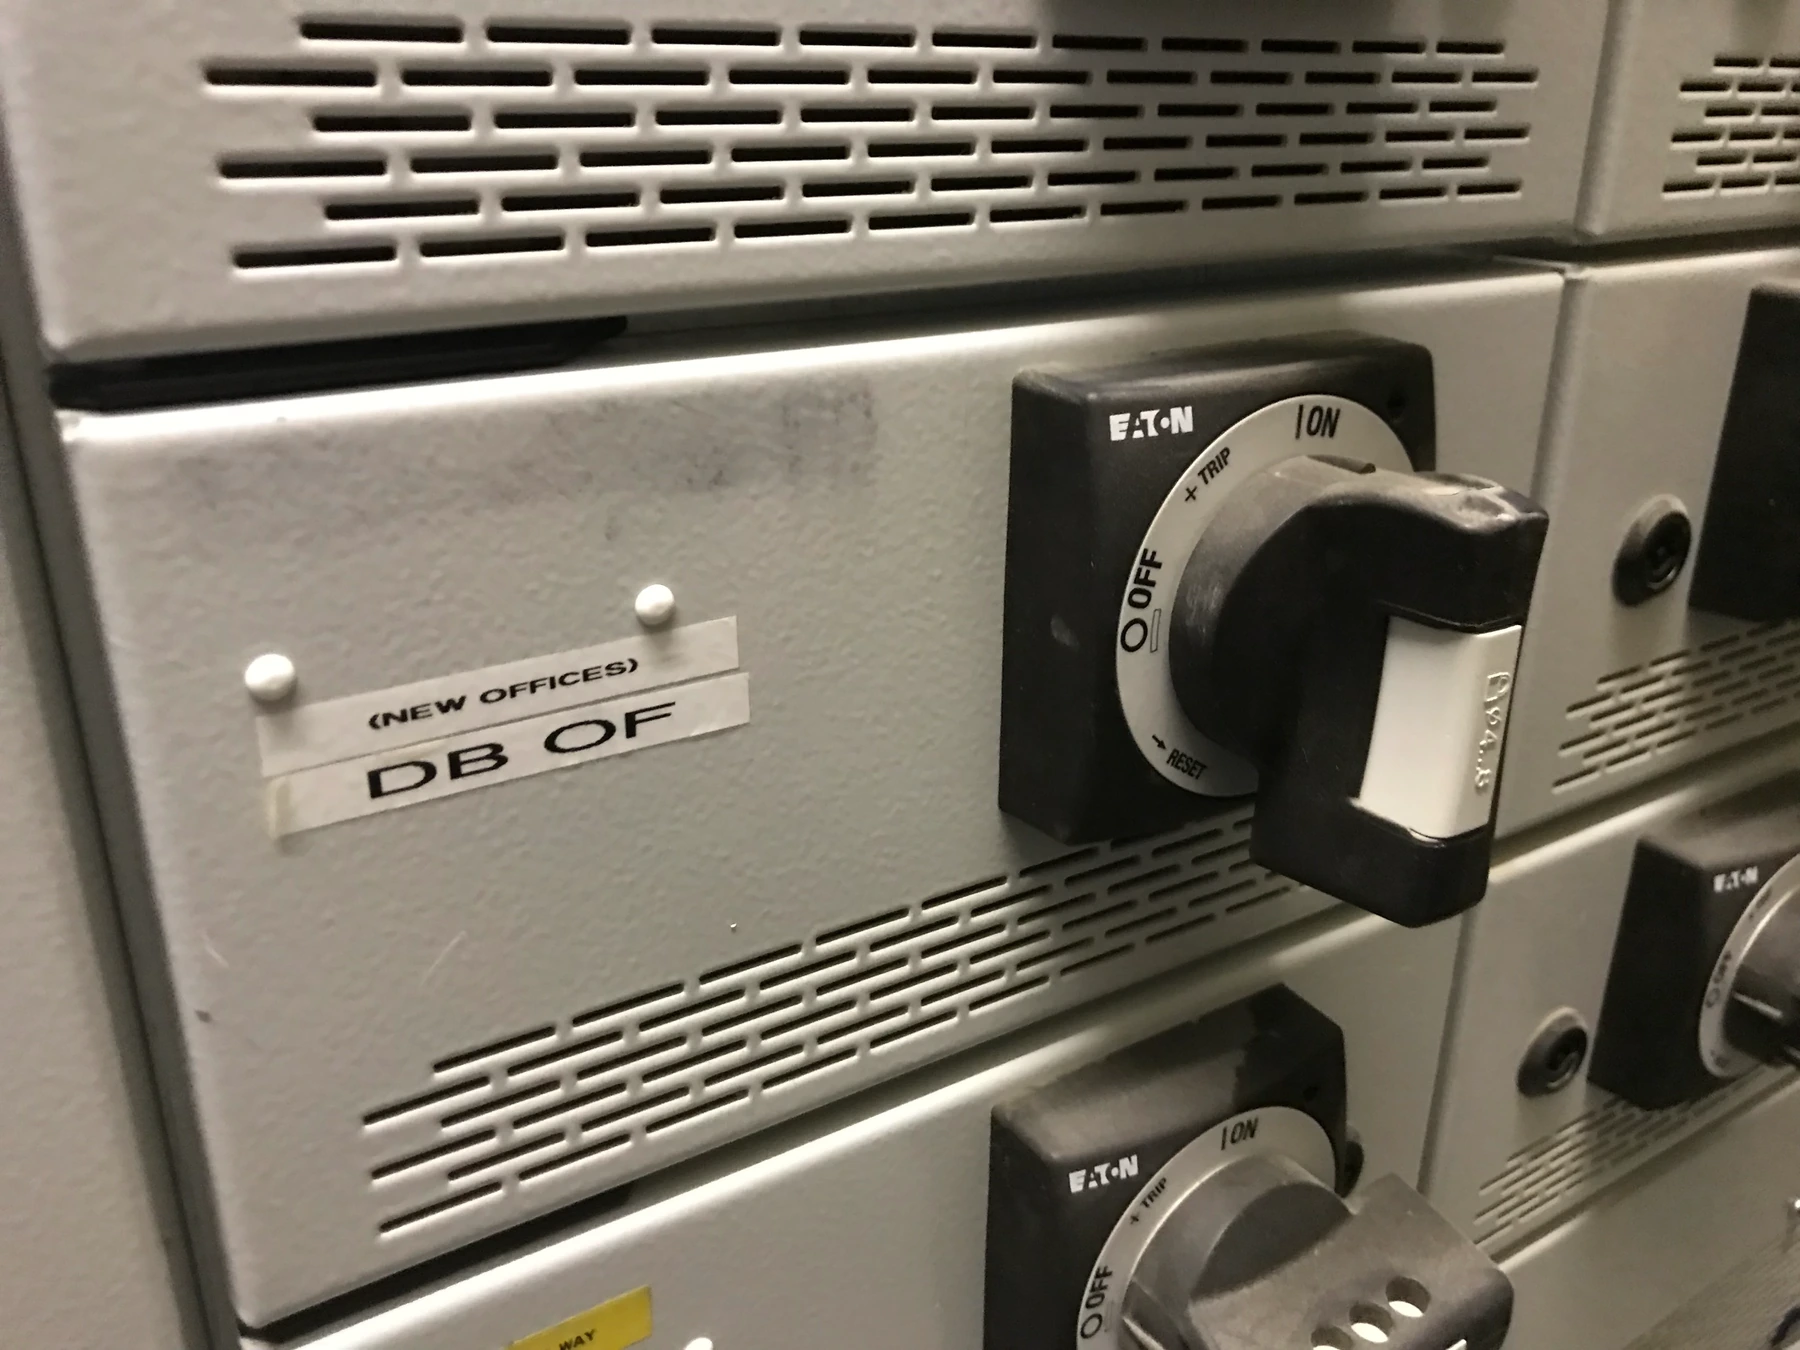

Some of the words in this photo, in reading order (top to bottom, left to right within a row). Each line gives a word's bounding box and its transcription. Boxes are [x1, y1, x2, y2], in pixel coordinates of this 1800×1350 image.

[1109, 405, 1193, 442] EATON
[1306, 405, 1341, 439] ON
[1197, 446, 1231, 486] TRIP
[1127, 547, 1163, 610] OFF
[368, 695, 467, 730] (NEW
[480, 657, 638, 703] OFFICES)
[366, 741, 509, 800] DB
[543, 701, 677, 755] OF
[1166, 748, 1208, 780] RESET
[1230, 1117, 1259, 1144] ON
[1068, 1154, 1139, 1195] EATON
[1140, 1177, 1168, 1209] TRIP
[1085, 1265, 1113, 1310] OFF
